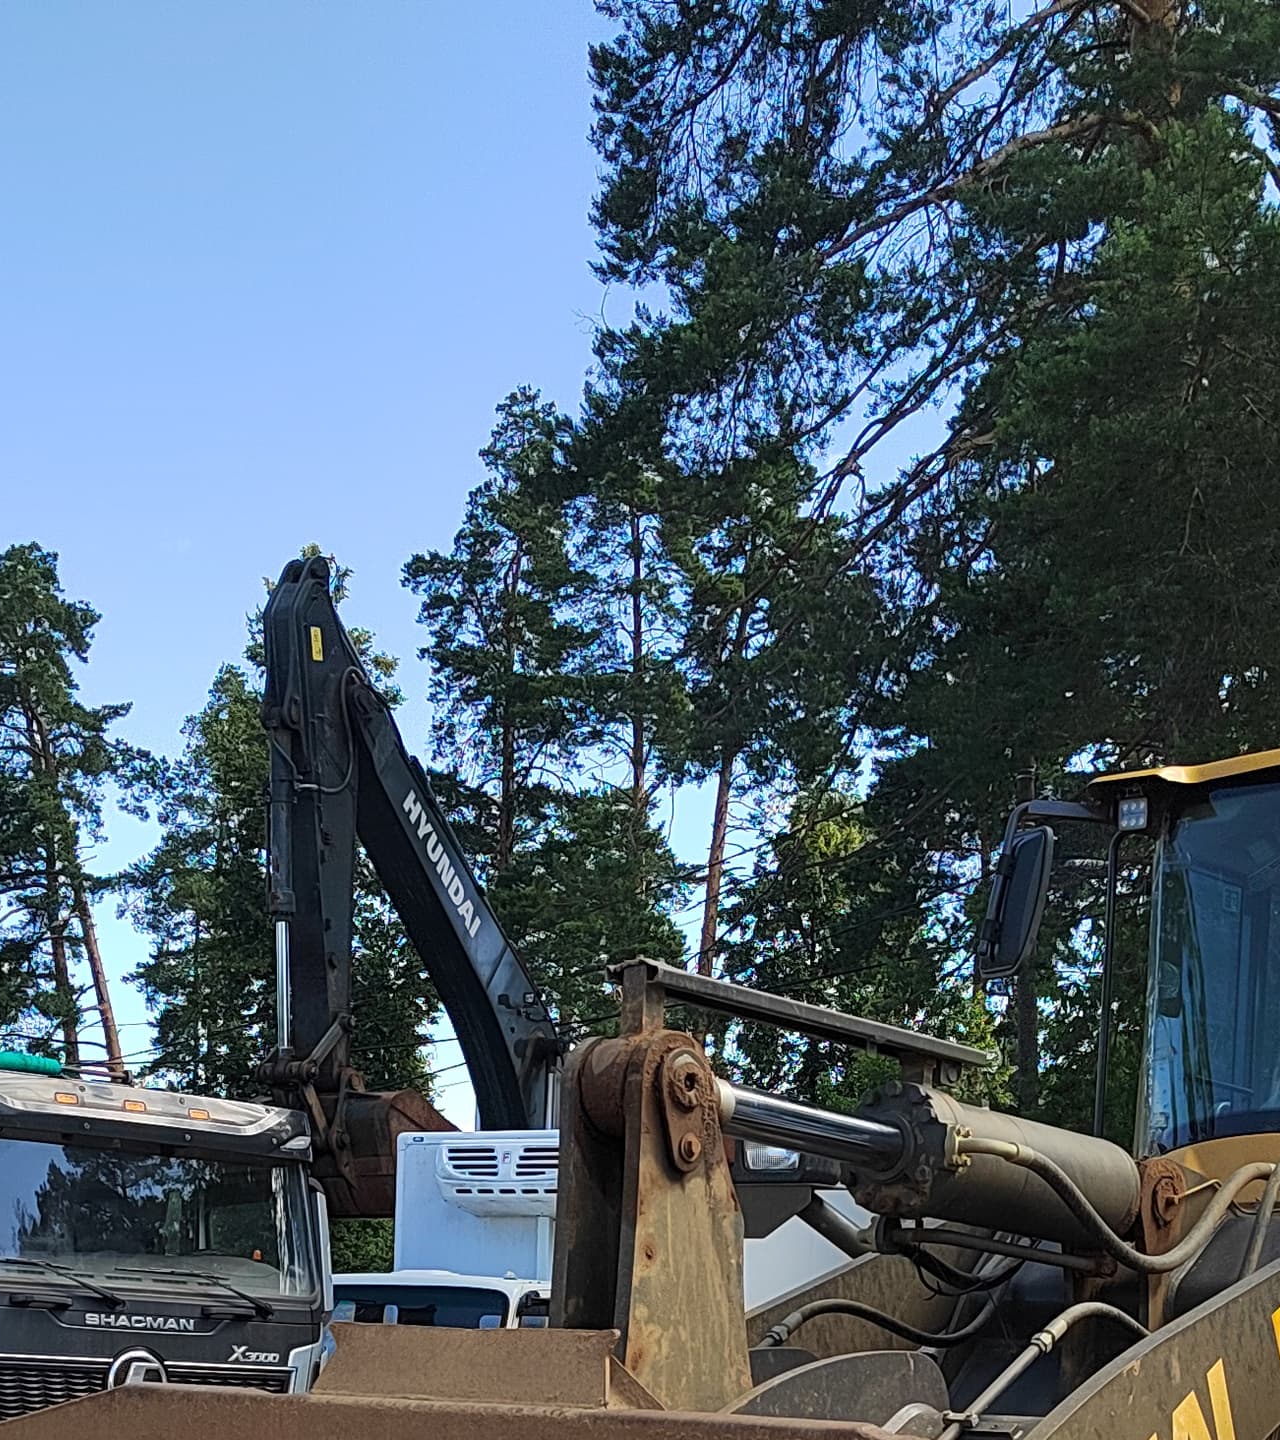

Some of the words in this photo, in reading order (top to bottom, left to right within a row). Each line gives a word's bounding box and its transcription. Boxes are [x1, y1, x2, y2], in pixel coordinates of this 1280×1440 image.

[402, 789, 482, 938] HYUNDAI
[85, 1312, 195, 1331] SHACMAN
[227, 1345, 280, 1363] X3000
